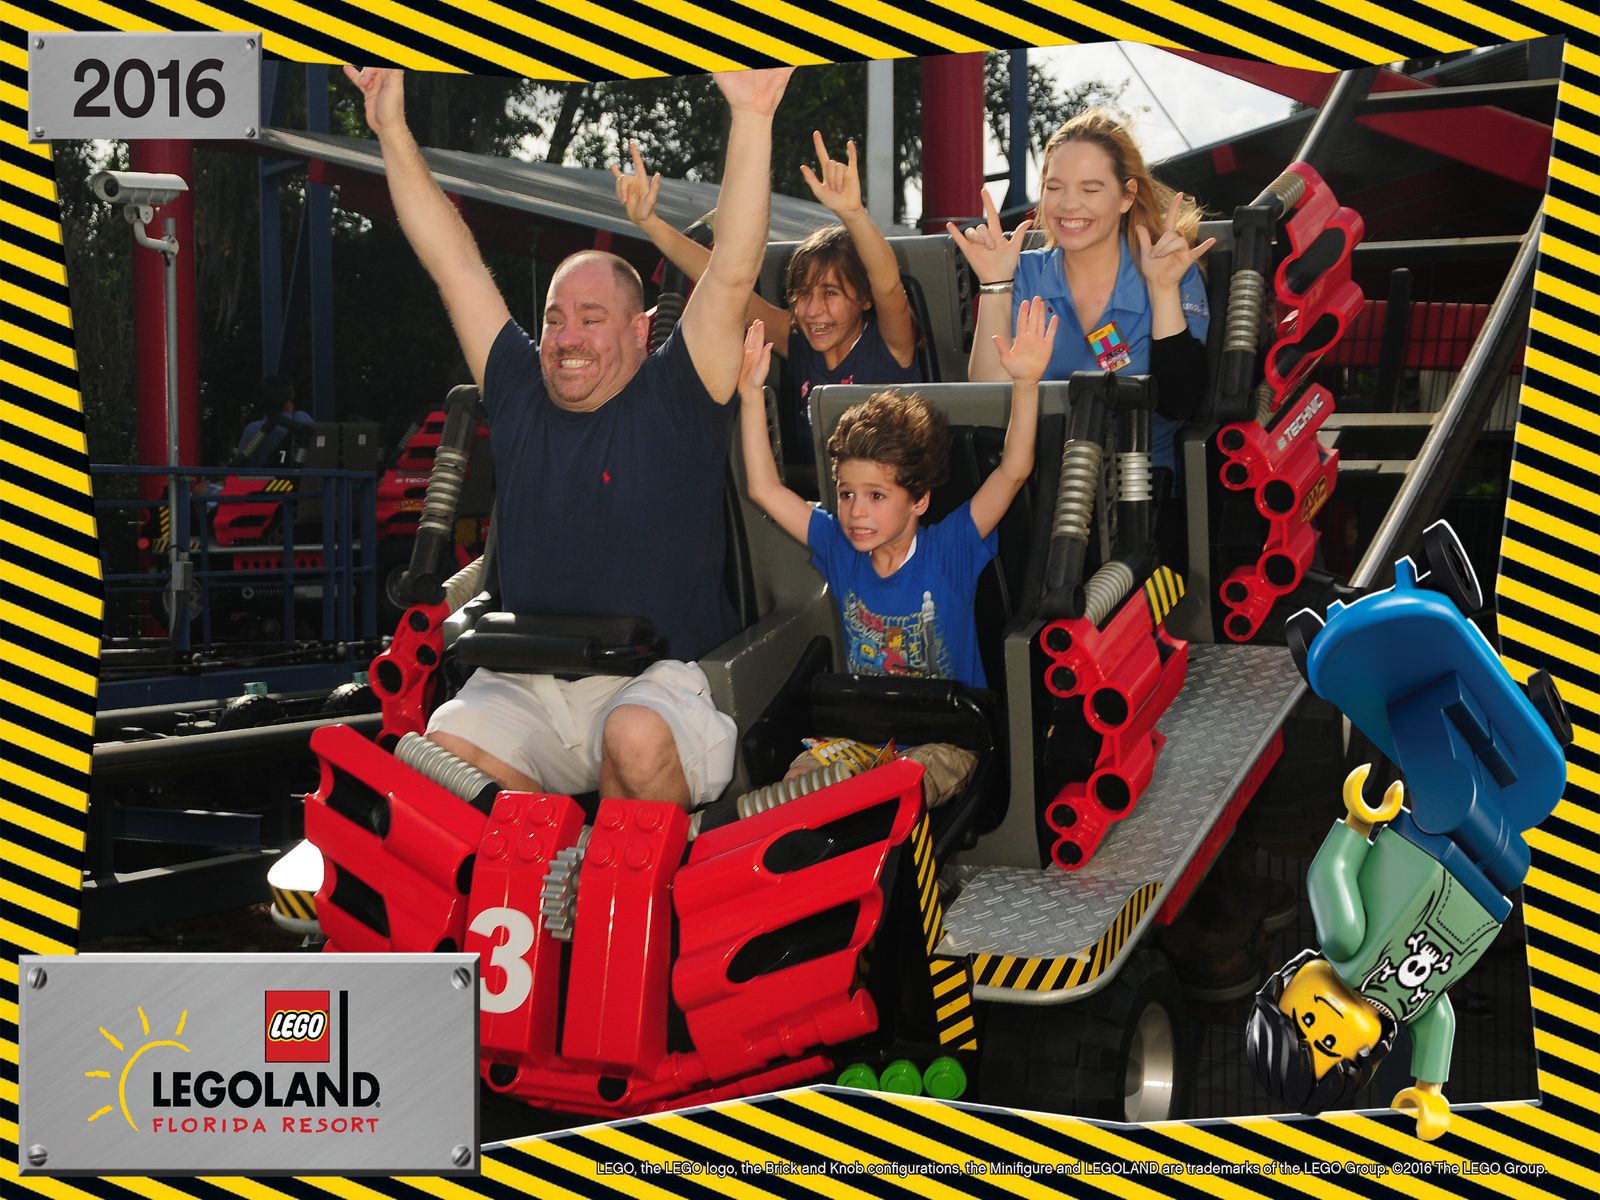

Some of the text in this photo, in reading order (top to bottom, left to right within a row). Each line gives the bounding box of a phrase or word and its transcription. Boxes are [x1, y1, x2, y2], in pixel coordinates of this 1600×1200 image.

[1283, 393, 1324, 441] TECHNIC
[279, 450, 287, 463] 7
[467, 906, 535, 1014] 3
